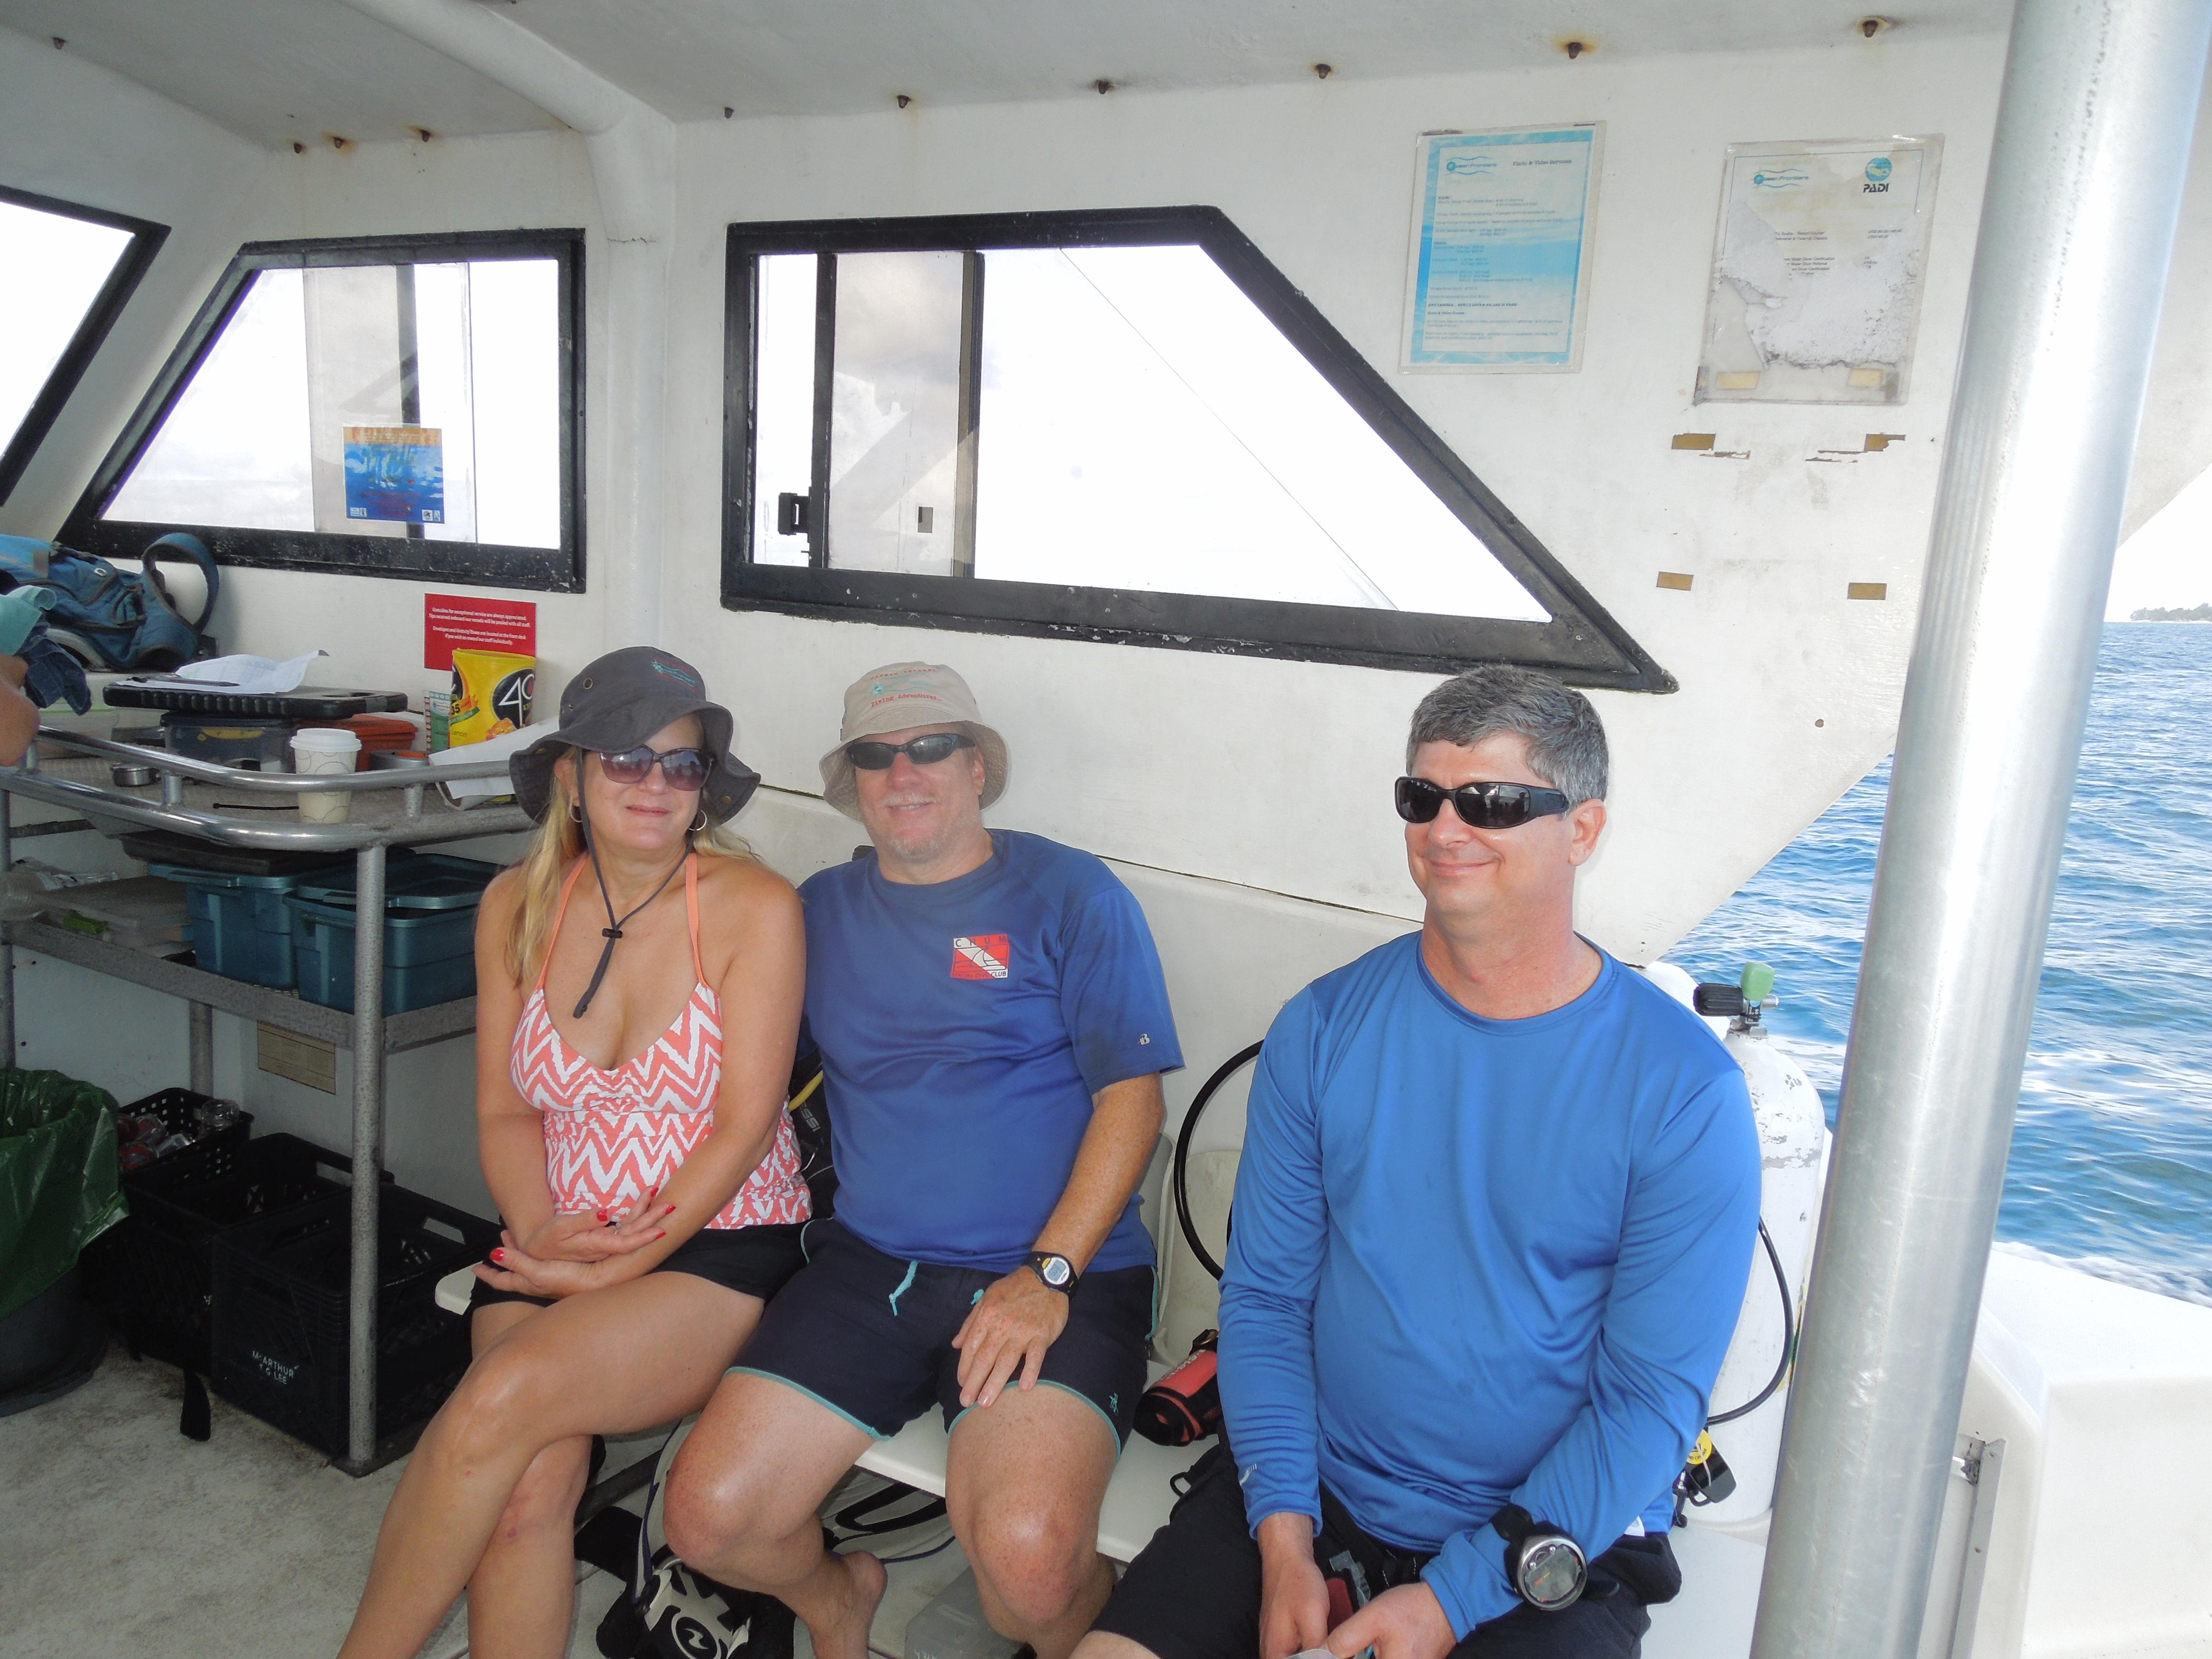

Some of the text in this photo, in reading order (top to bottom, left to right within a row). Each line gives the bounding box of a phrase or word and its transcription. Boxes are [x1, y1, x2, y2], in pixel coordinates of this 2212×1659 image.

[1863, 183, 1890, 193] PADI
[871, 696, 894, 708] Diving
[955, 935, 1007, 947] CHUM
[274, 1371, 287, 1385] LEE
